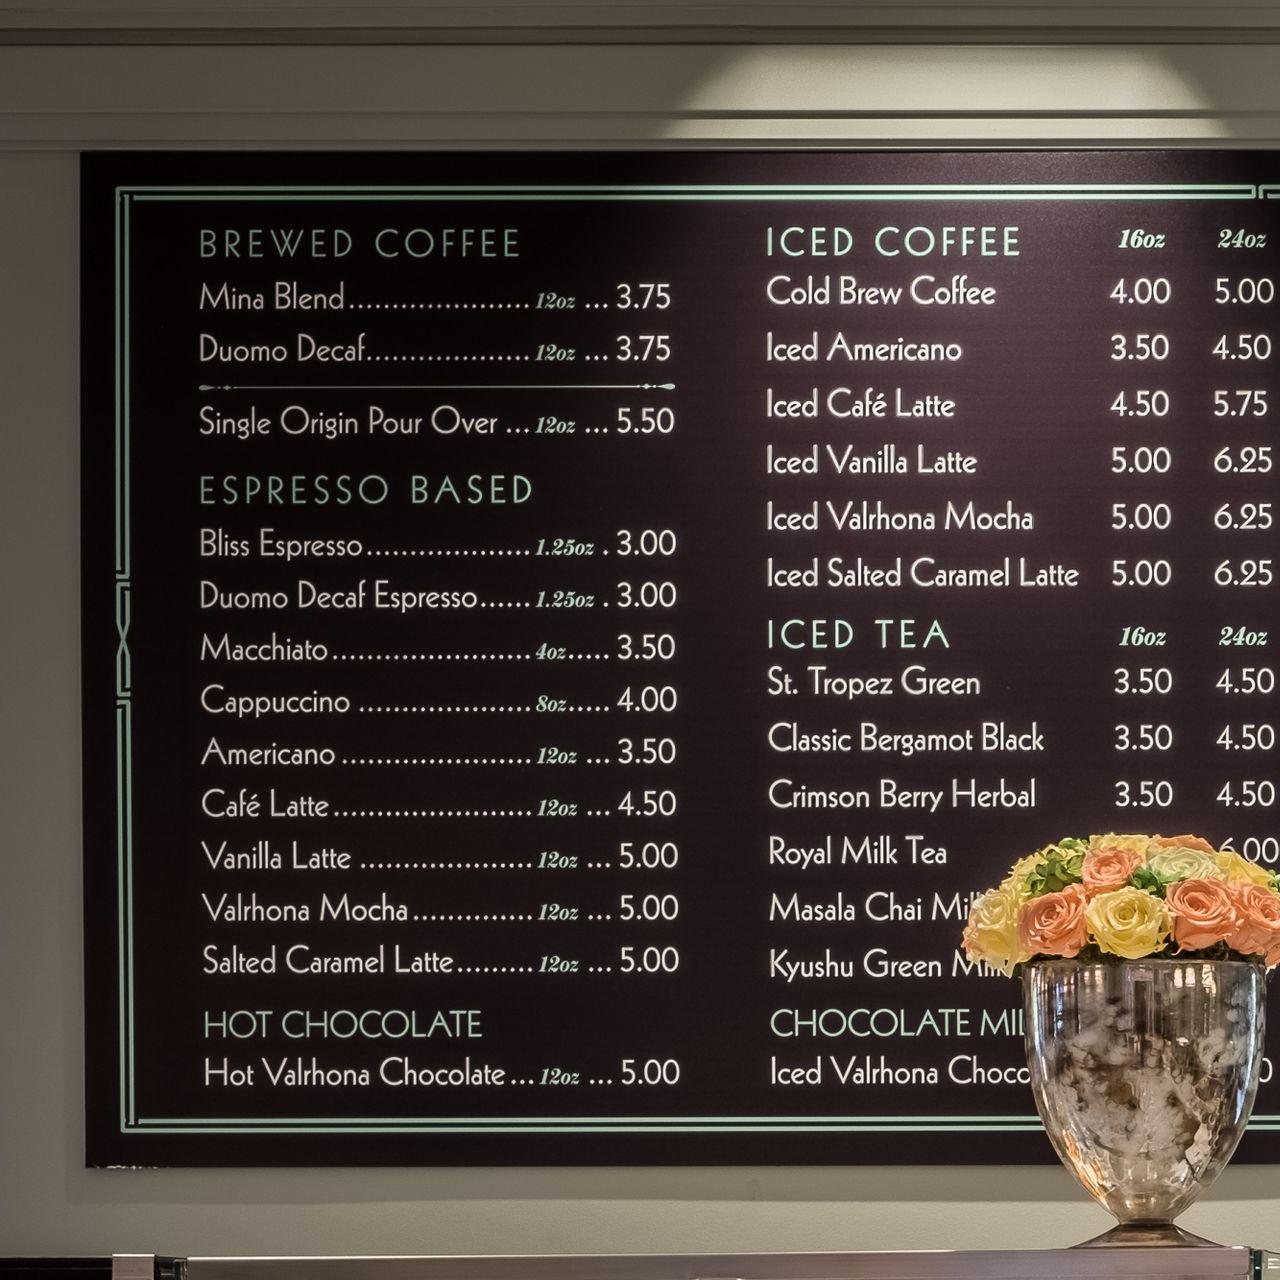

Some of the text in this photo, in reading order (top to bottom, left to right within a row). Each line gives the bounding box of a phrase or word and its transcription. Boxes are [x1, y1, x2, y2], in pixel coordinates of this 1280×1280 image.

[200, 228, 520, 258] BREWED COFFEE
[767, 226, 1266, 257] ICED COFFEE 16oz 24oz
[199, 281, 671, 310] Mina Blend 12oz 3.75
[766, 331, 1272, 362] Iced Americano 3.50 4.50
[200, 474, 532, 505] ESPRESSO BASED
[767, 556, 1273, 588] Iced Salted Caramel Latte 5.00 6.25
[200, 579, 677, 614] Duomo Decaf Espresso 1.25oz 3.00
[768, 619, 950, 650] ICED TEA
[201, 788, 677, 818] Café Latte 12oz 4.50
[769, 889, 976, 922] Masala Chai Mi
[204, 1009, 483, 1039] HOT CHOCOLATE
[770, 1008, 1026, 1038] CHOCOLATE MIL
[205, 1056, 681, 1086] Hot Valrhona Chocolate 12oz 5.00
[771, 1054, 1031, 1085] Iced Valrhona Choco
